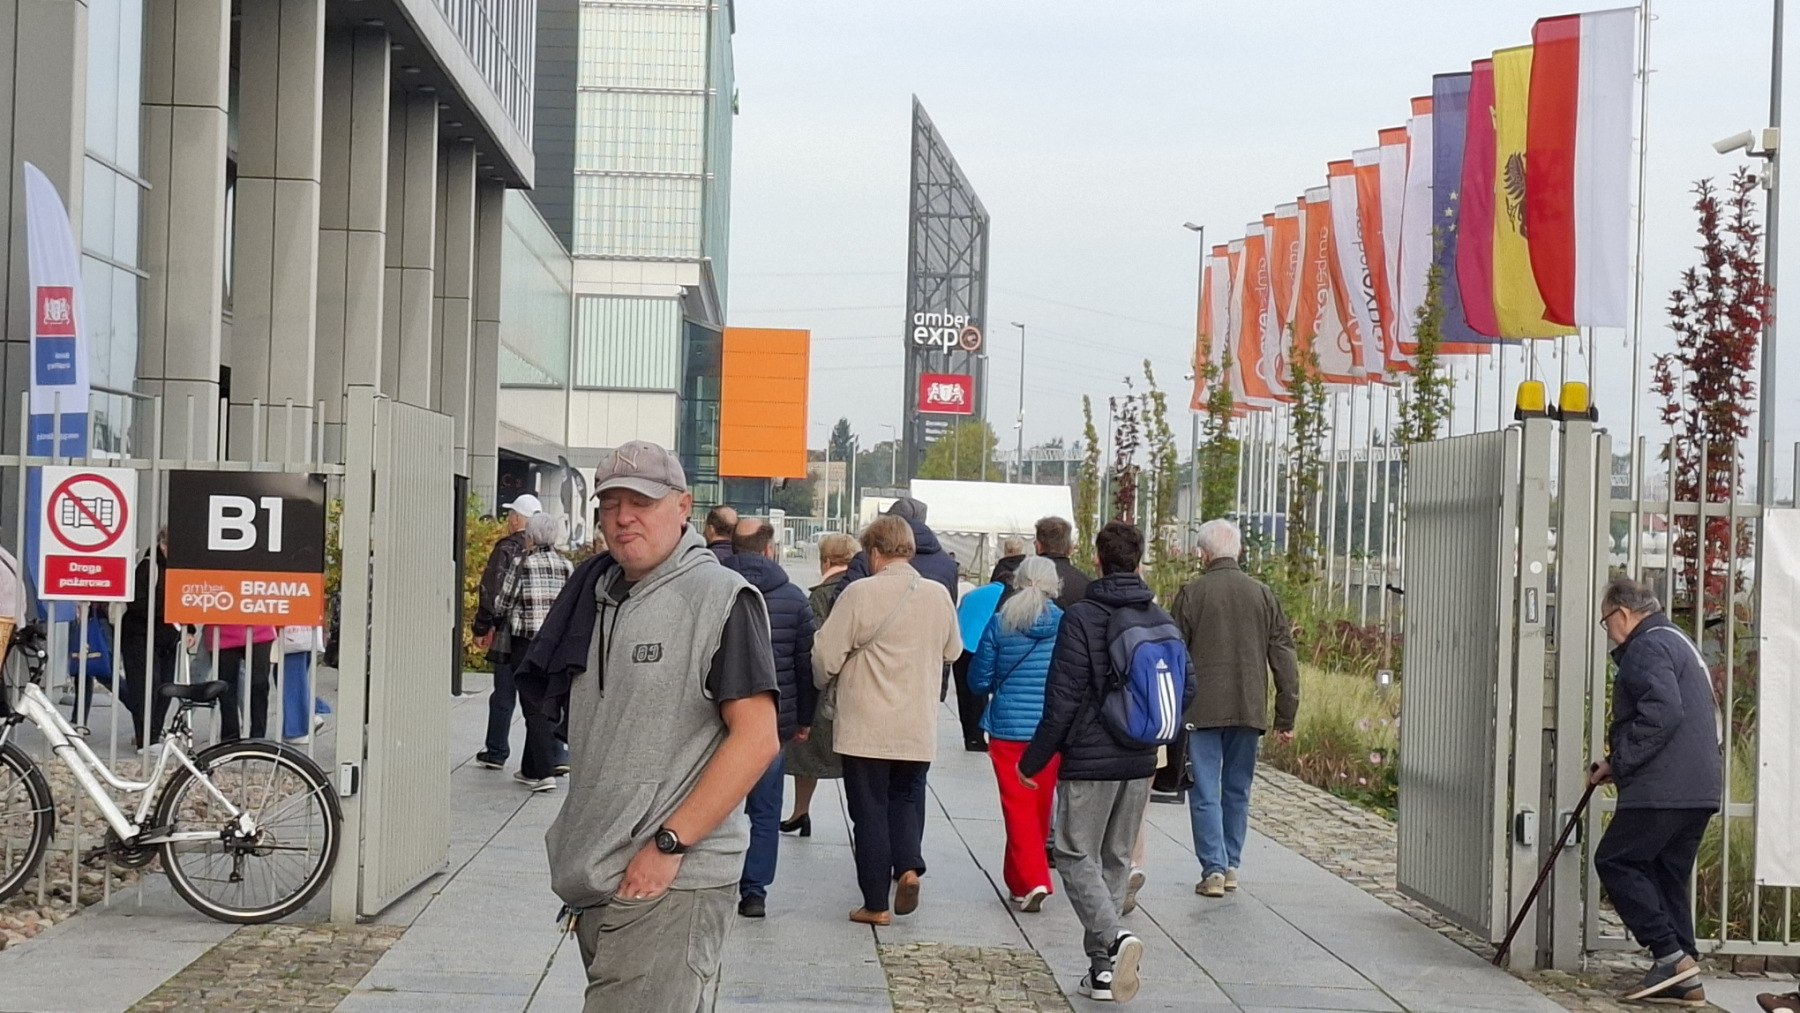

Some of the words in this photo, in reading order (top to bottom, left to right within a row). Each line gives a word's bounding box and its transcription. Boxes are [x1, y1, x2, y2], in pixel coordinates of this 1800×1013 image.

[913, 307, 970, 329] amber
[913, 325, 982, 355] expo
[207, 494, 284, 553] B1
[69, 562, 102, 575] Droga
[240, 580, 311, 597] BRAMA
[181, 591, 234, 613] expo
[240, 598, 290, 615] GATE
